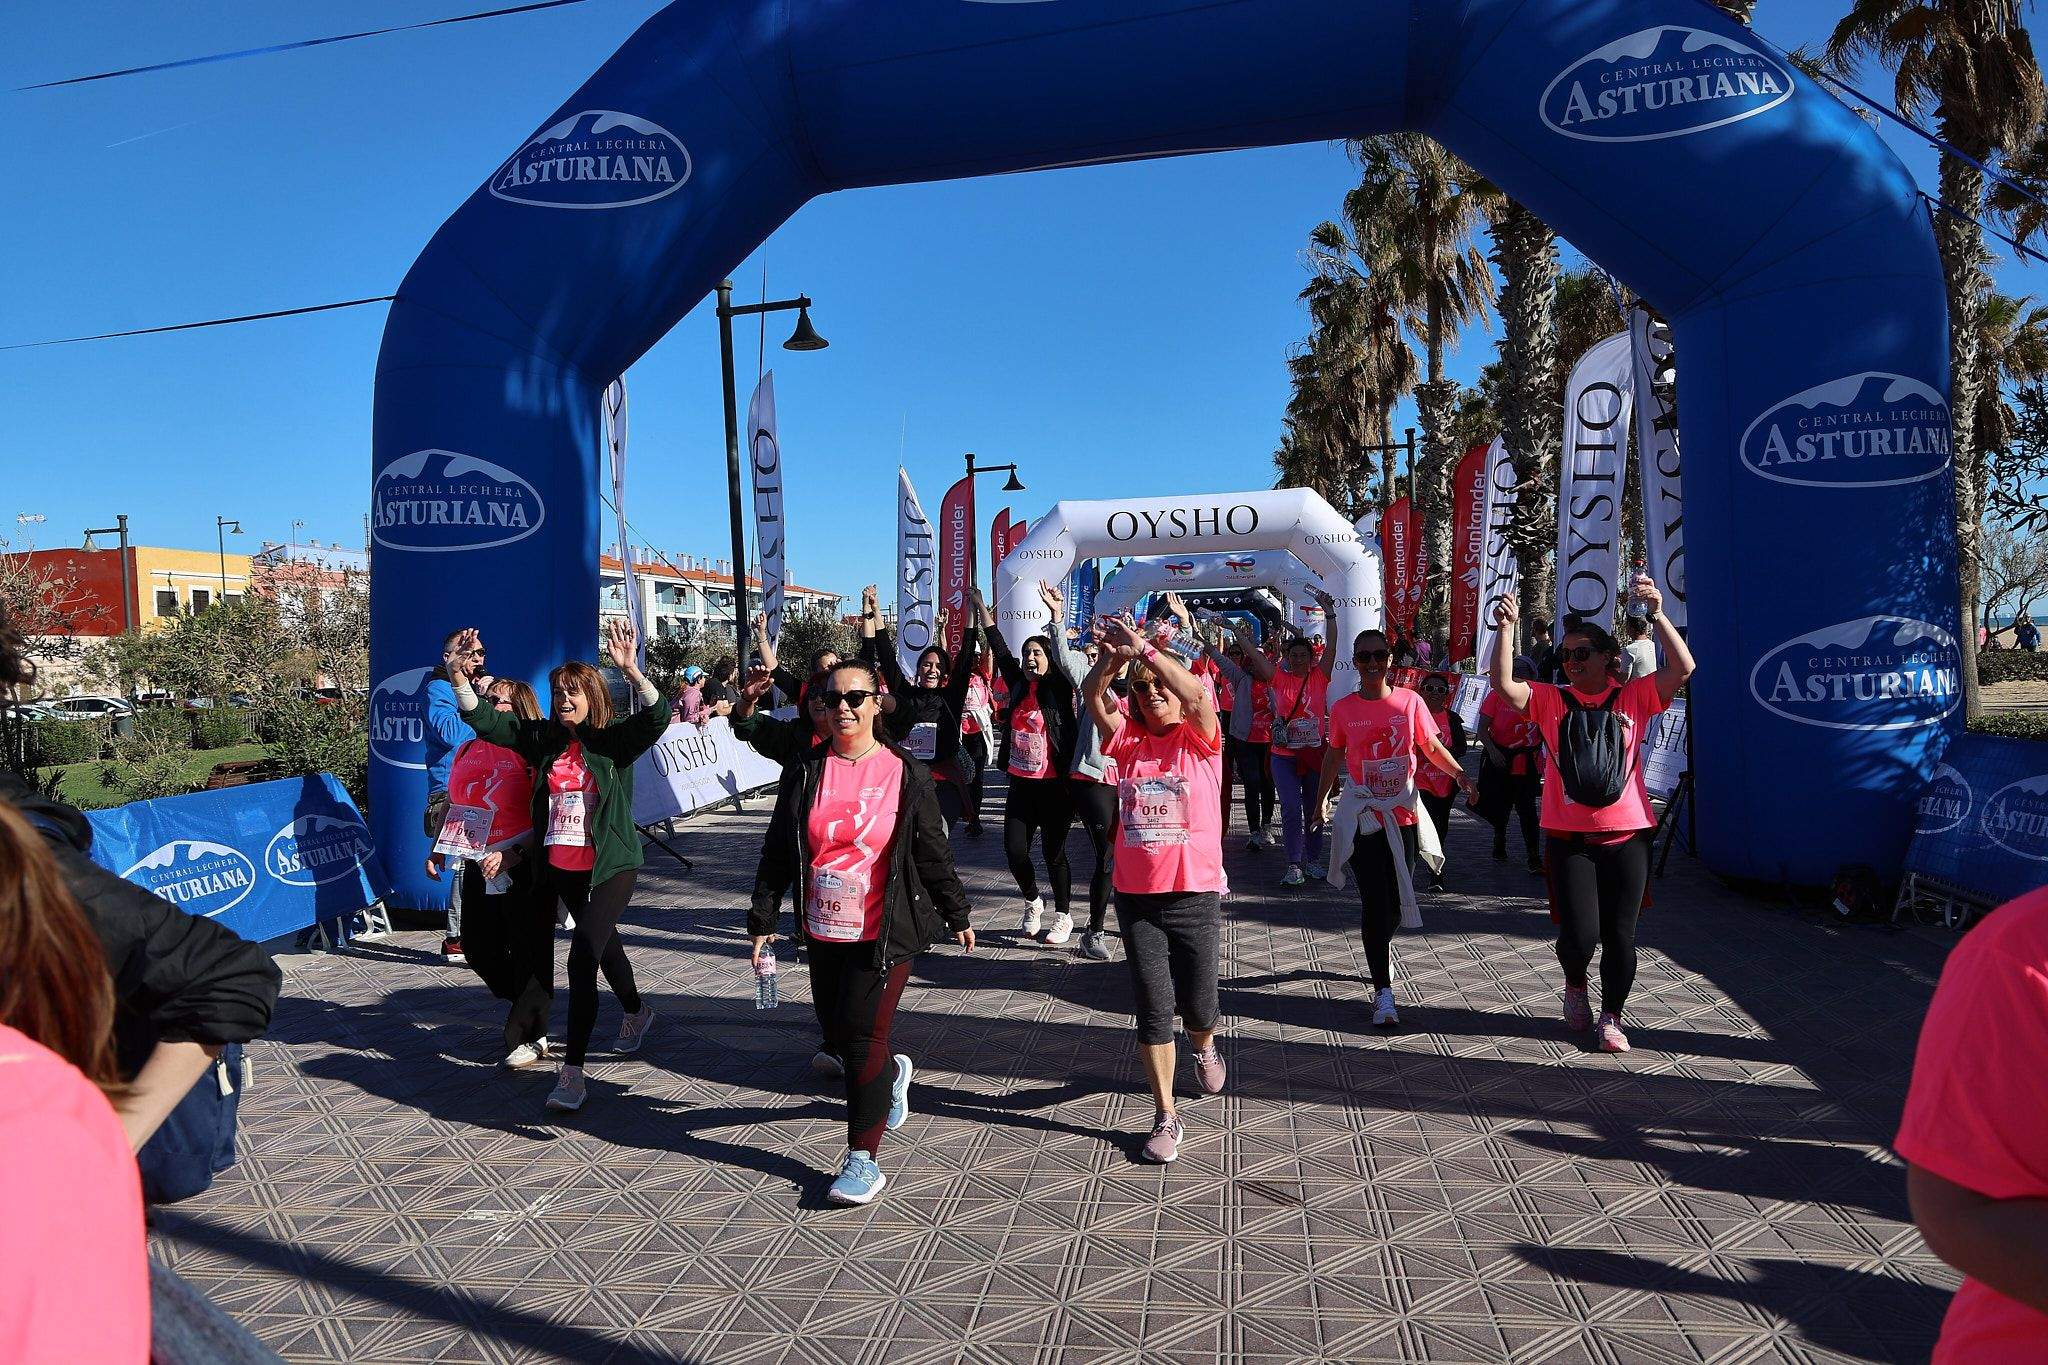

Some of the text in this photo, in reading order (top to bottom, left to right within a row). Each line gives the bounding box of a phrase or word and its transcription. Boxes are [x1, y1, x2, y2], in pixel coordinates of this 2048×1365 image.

[1600, 55, 1766, 84] CENTRAL LECHERA
[1560, 71, 1783, 127] ASTURIANA
[530, 139, 667, 159] CENTRAL LECHERA
[498, 155, 675, 191] ASTURIANA
[1798, 411, 1884, 428] CENTRAL
[1758, 423, 1950, 467] ASTURIANA
[387, 484, 523, 498] CENTRAL LECHERA
[1566, 381, 1622, 619] OYSHO
[373, 491, 530, 529] ASTURIANA
[1106, 504, 1260, 541] OYSHO
[950, 503, 965, 588] Santander
[1304, 533, 1352, 546] OYSHO
[1394, 520, 1406, 586] Santander
[1019, 549, 1064, 560] OYSHO
[1457, 469, 1488, 647] Sports Santander
[903, 496, 933, 652] OYSHO
[1001, 610, 1042, 621] OYSHO
[1333, 596, 1377, 608] OYSHO
[1808, 655, 1894, 669] CENTRAL
[1768, 660, 1961, 703] ASTURIANA
[650, 733, 718, 778] OYSHO
[1382, 778, 1400, 788] 016
[560, 814, 581, 825] 016
[1142, 804, 1168, 816] 016
[456, 827, 476, 839] 016
[150, 857, 239, 884] CENTRAL LECHERA
[276, 838, 371, 876] ASTURIANA
[153, 867, 250, 906] STURIANA
[816, 898, 842, 913] 016
